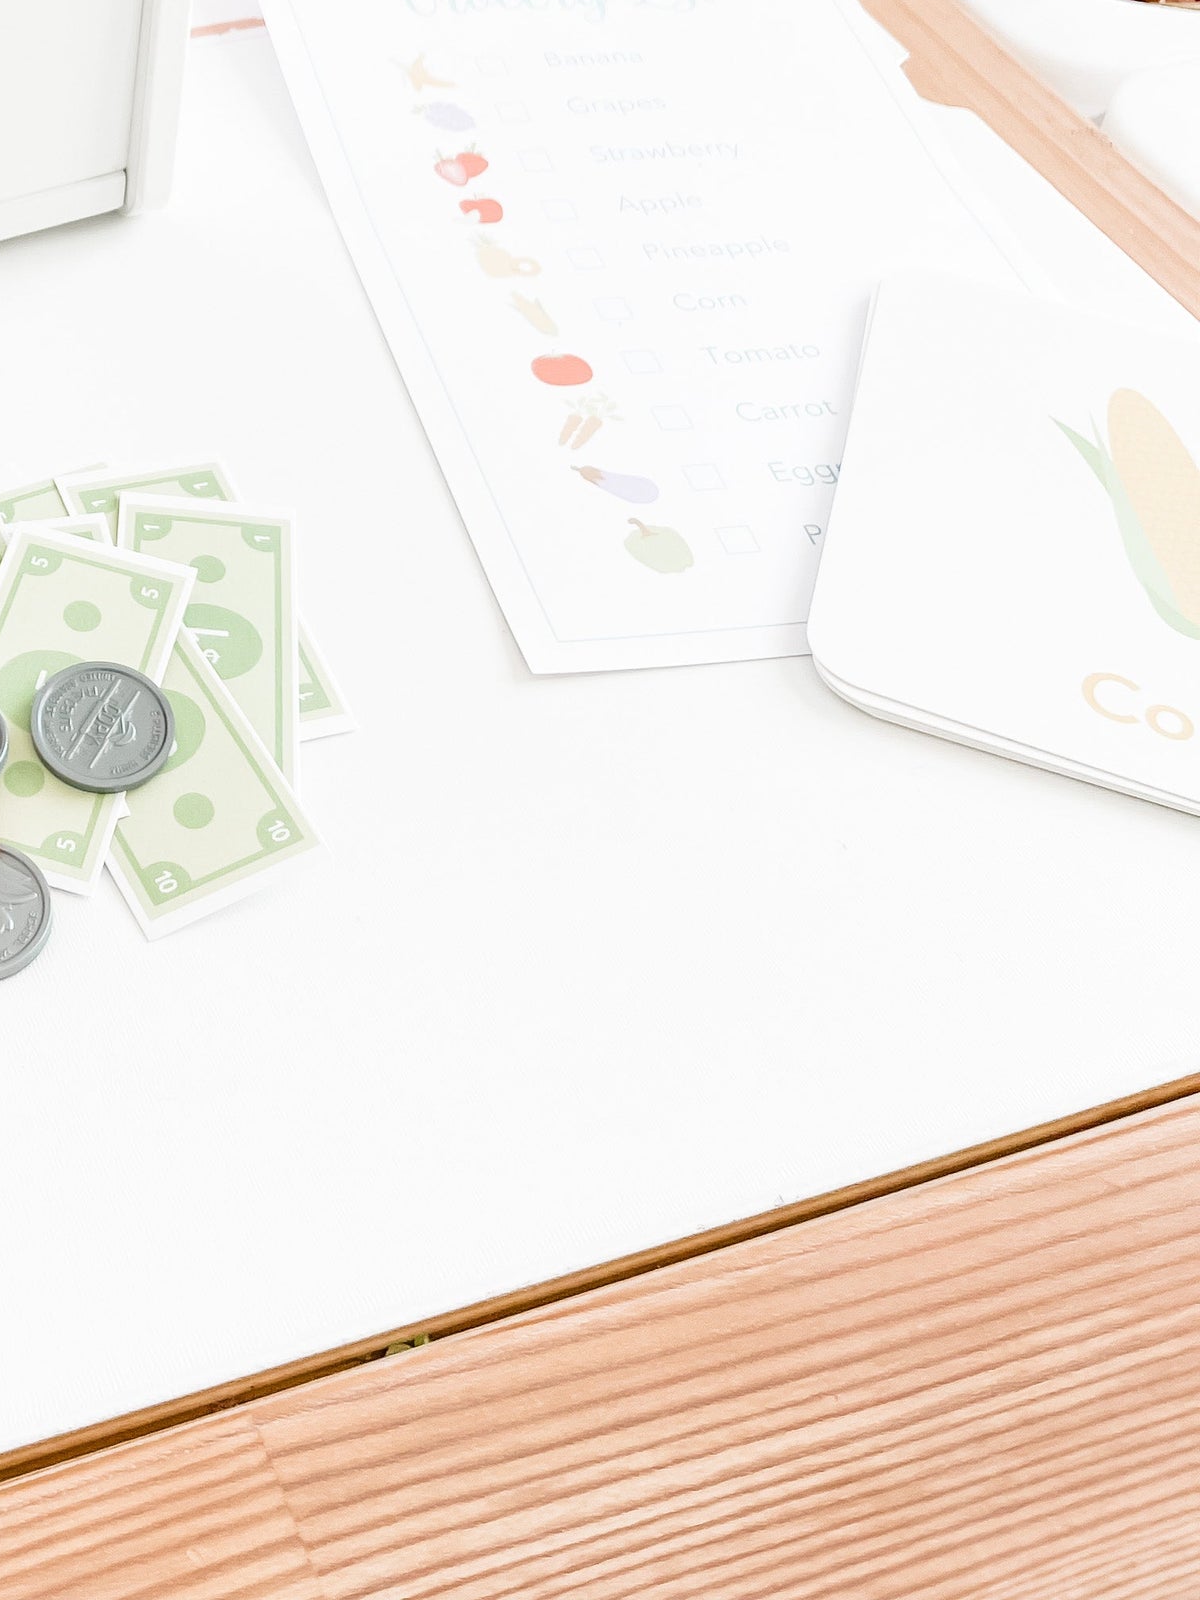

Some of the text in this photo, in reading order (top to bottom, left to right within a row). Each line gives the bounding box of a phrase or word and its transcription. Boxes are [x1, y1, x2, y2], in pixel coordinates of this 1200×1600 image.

[544, 48, 644, 70] Banana
[566, 92, 668, 117] Grapes
[588, 138, 741, 166] Strawberry
[617, 190, 703, 216] Apple
[641, 234, 791, 264] Pineapple
[672, 290, 748, 313] Corn
[703, 340, 822, 369] Tomato
[736, 398, 838, 425] Carrot
[31, 555, 49, 569] 5
[141, 585, 159, 601] 5
[1081, 671, 1195, 742] Co
[267, 820, 290, 842] 10
[56, 838, 76, 853] 5
[154, 870, 178, 893] 10
